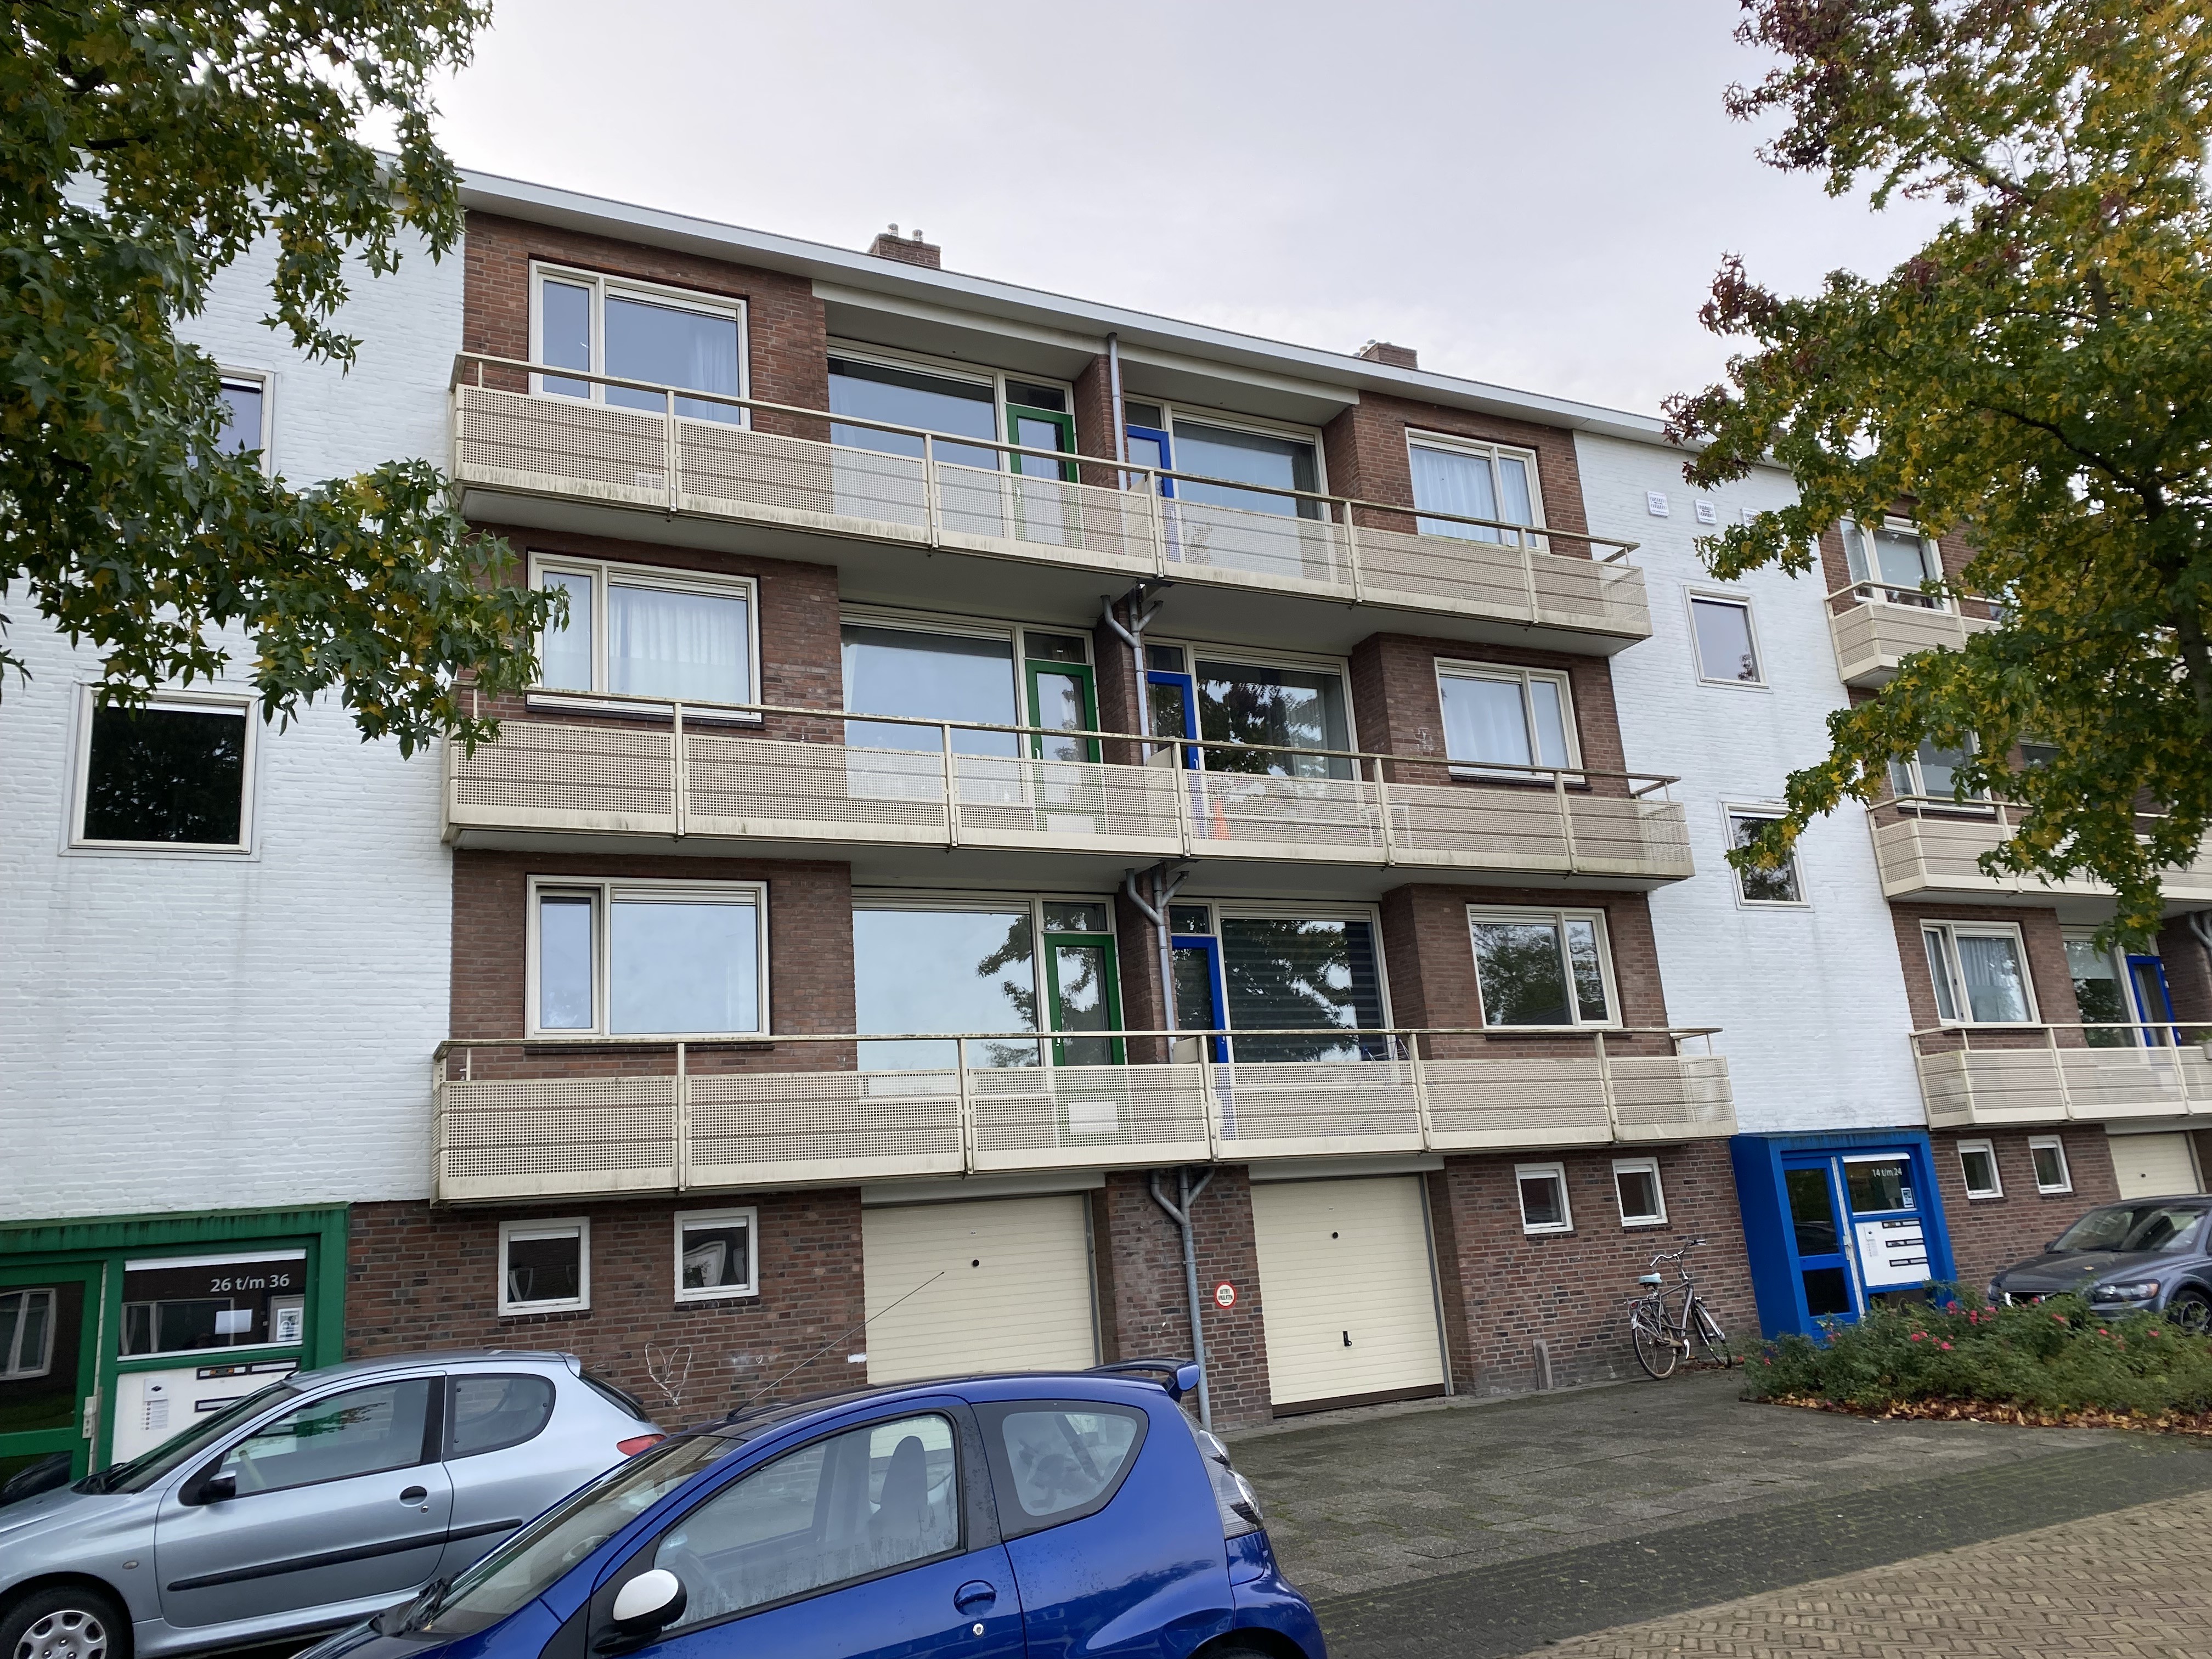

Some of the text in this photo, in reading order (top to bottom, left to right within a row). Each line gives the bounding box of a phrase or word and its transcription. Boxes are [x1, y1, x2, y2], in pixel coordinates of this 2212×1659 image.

[1872, 1169, 1881, 1177] 14
[1894, 1167, 1902, 1176] 24
[210, 1273, 290, 1292] 26 t/m 36
